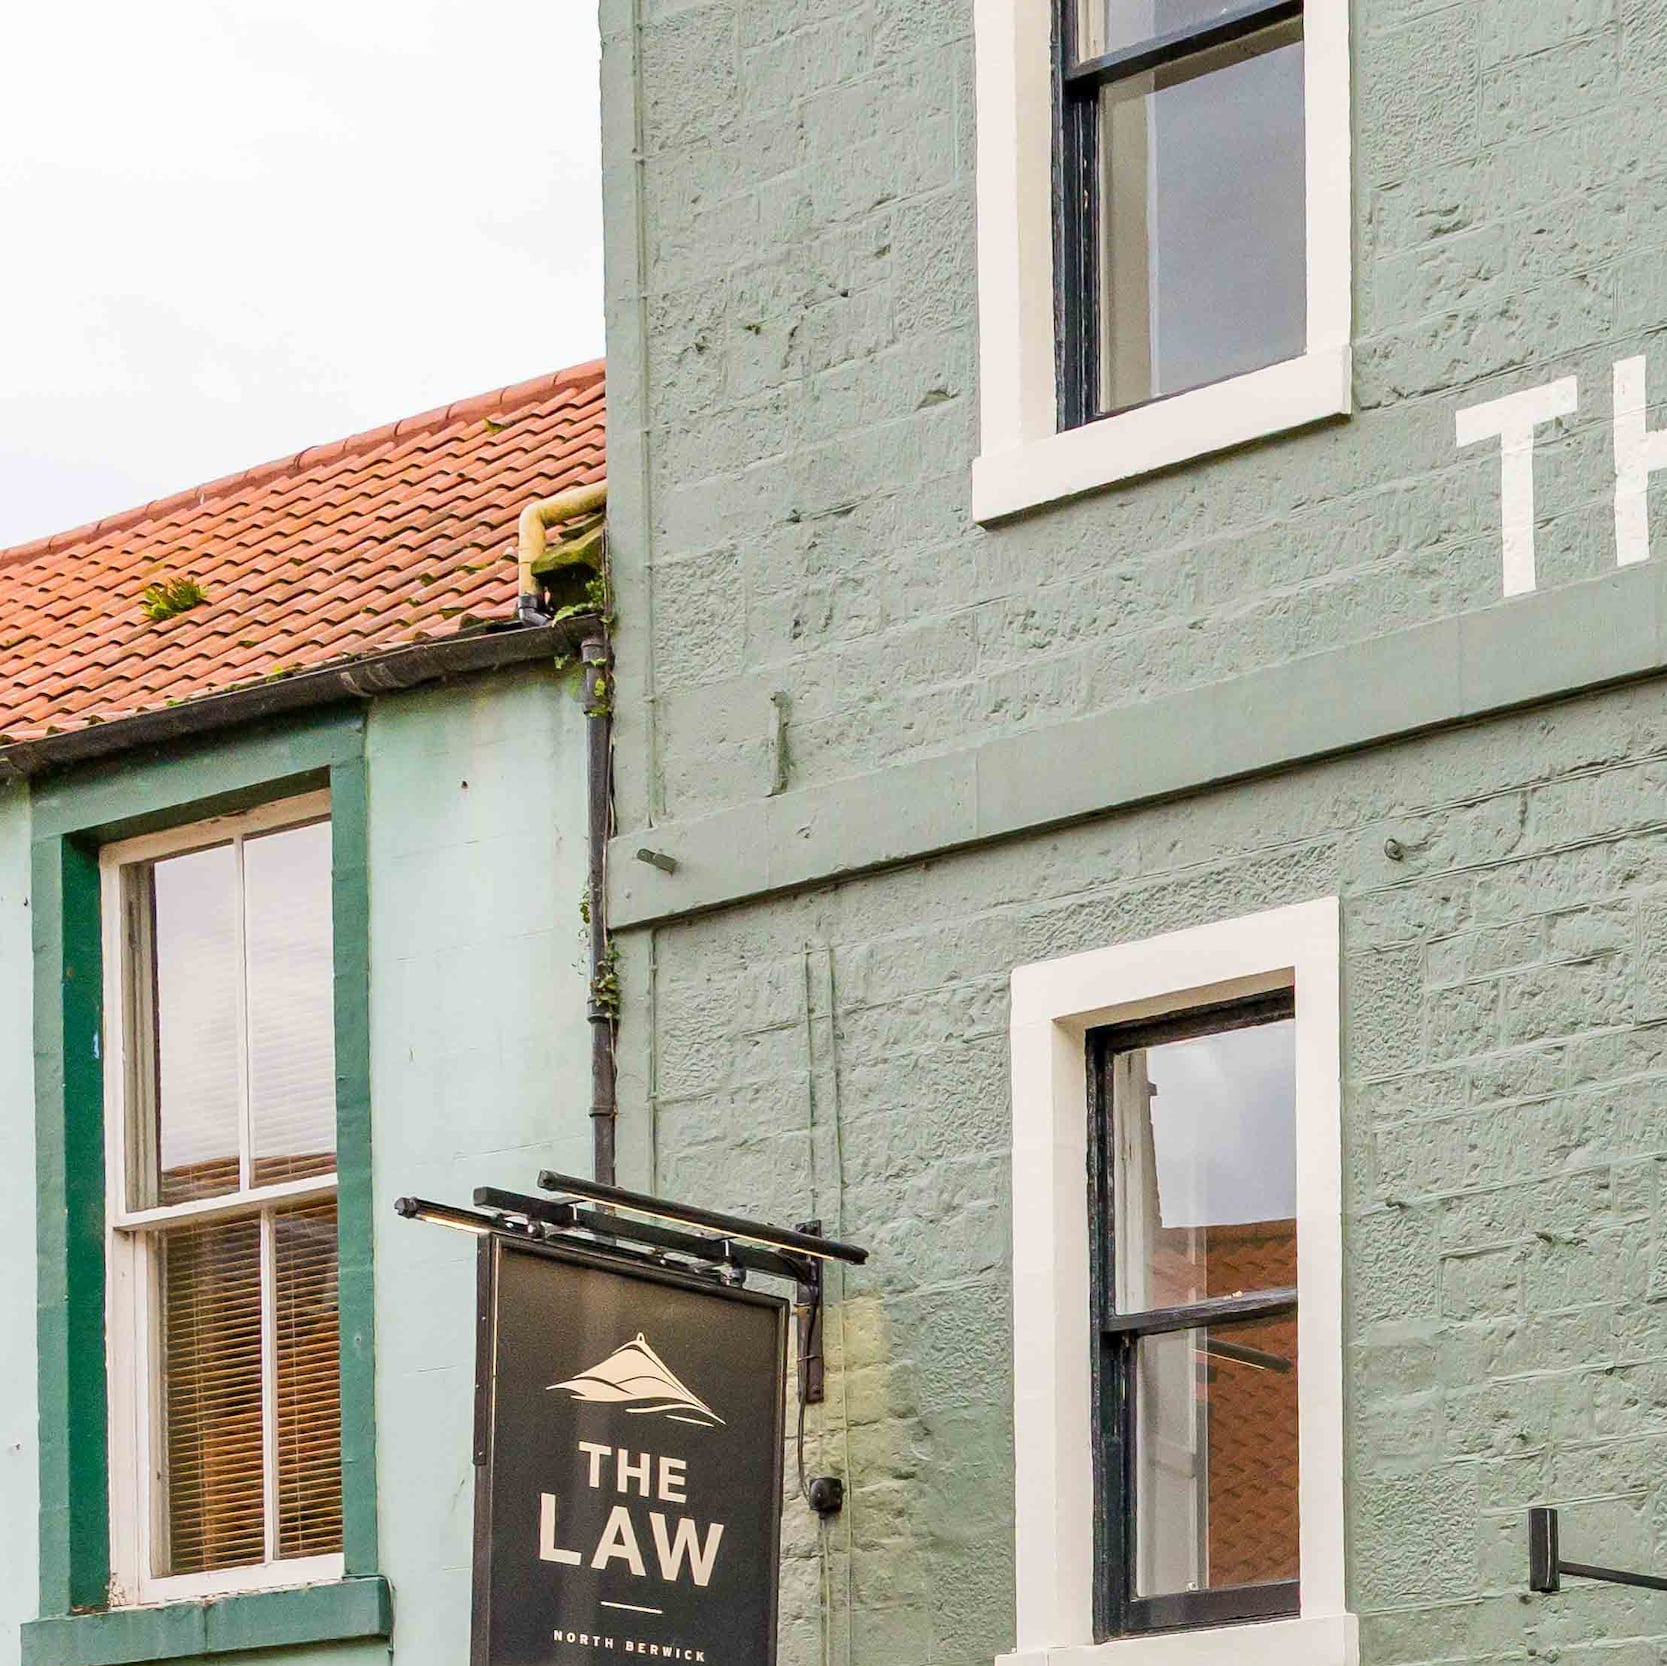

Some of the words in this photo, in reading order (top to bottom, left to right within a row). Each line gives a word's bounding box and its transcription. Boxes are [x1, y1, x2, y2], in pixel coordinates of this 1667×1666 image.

[578, 1440, 687, 1504] THE
[538, 1492, 725, 1587] LAW
[553, 1629, 614, 1649] NORTH
[625, 1640, 705, 1662] BERWICK
